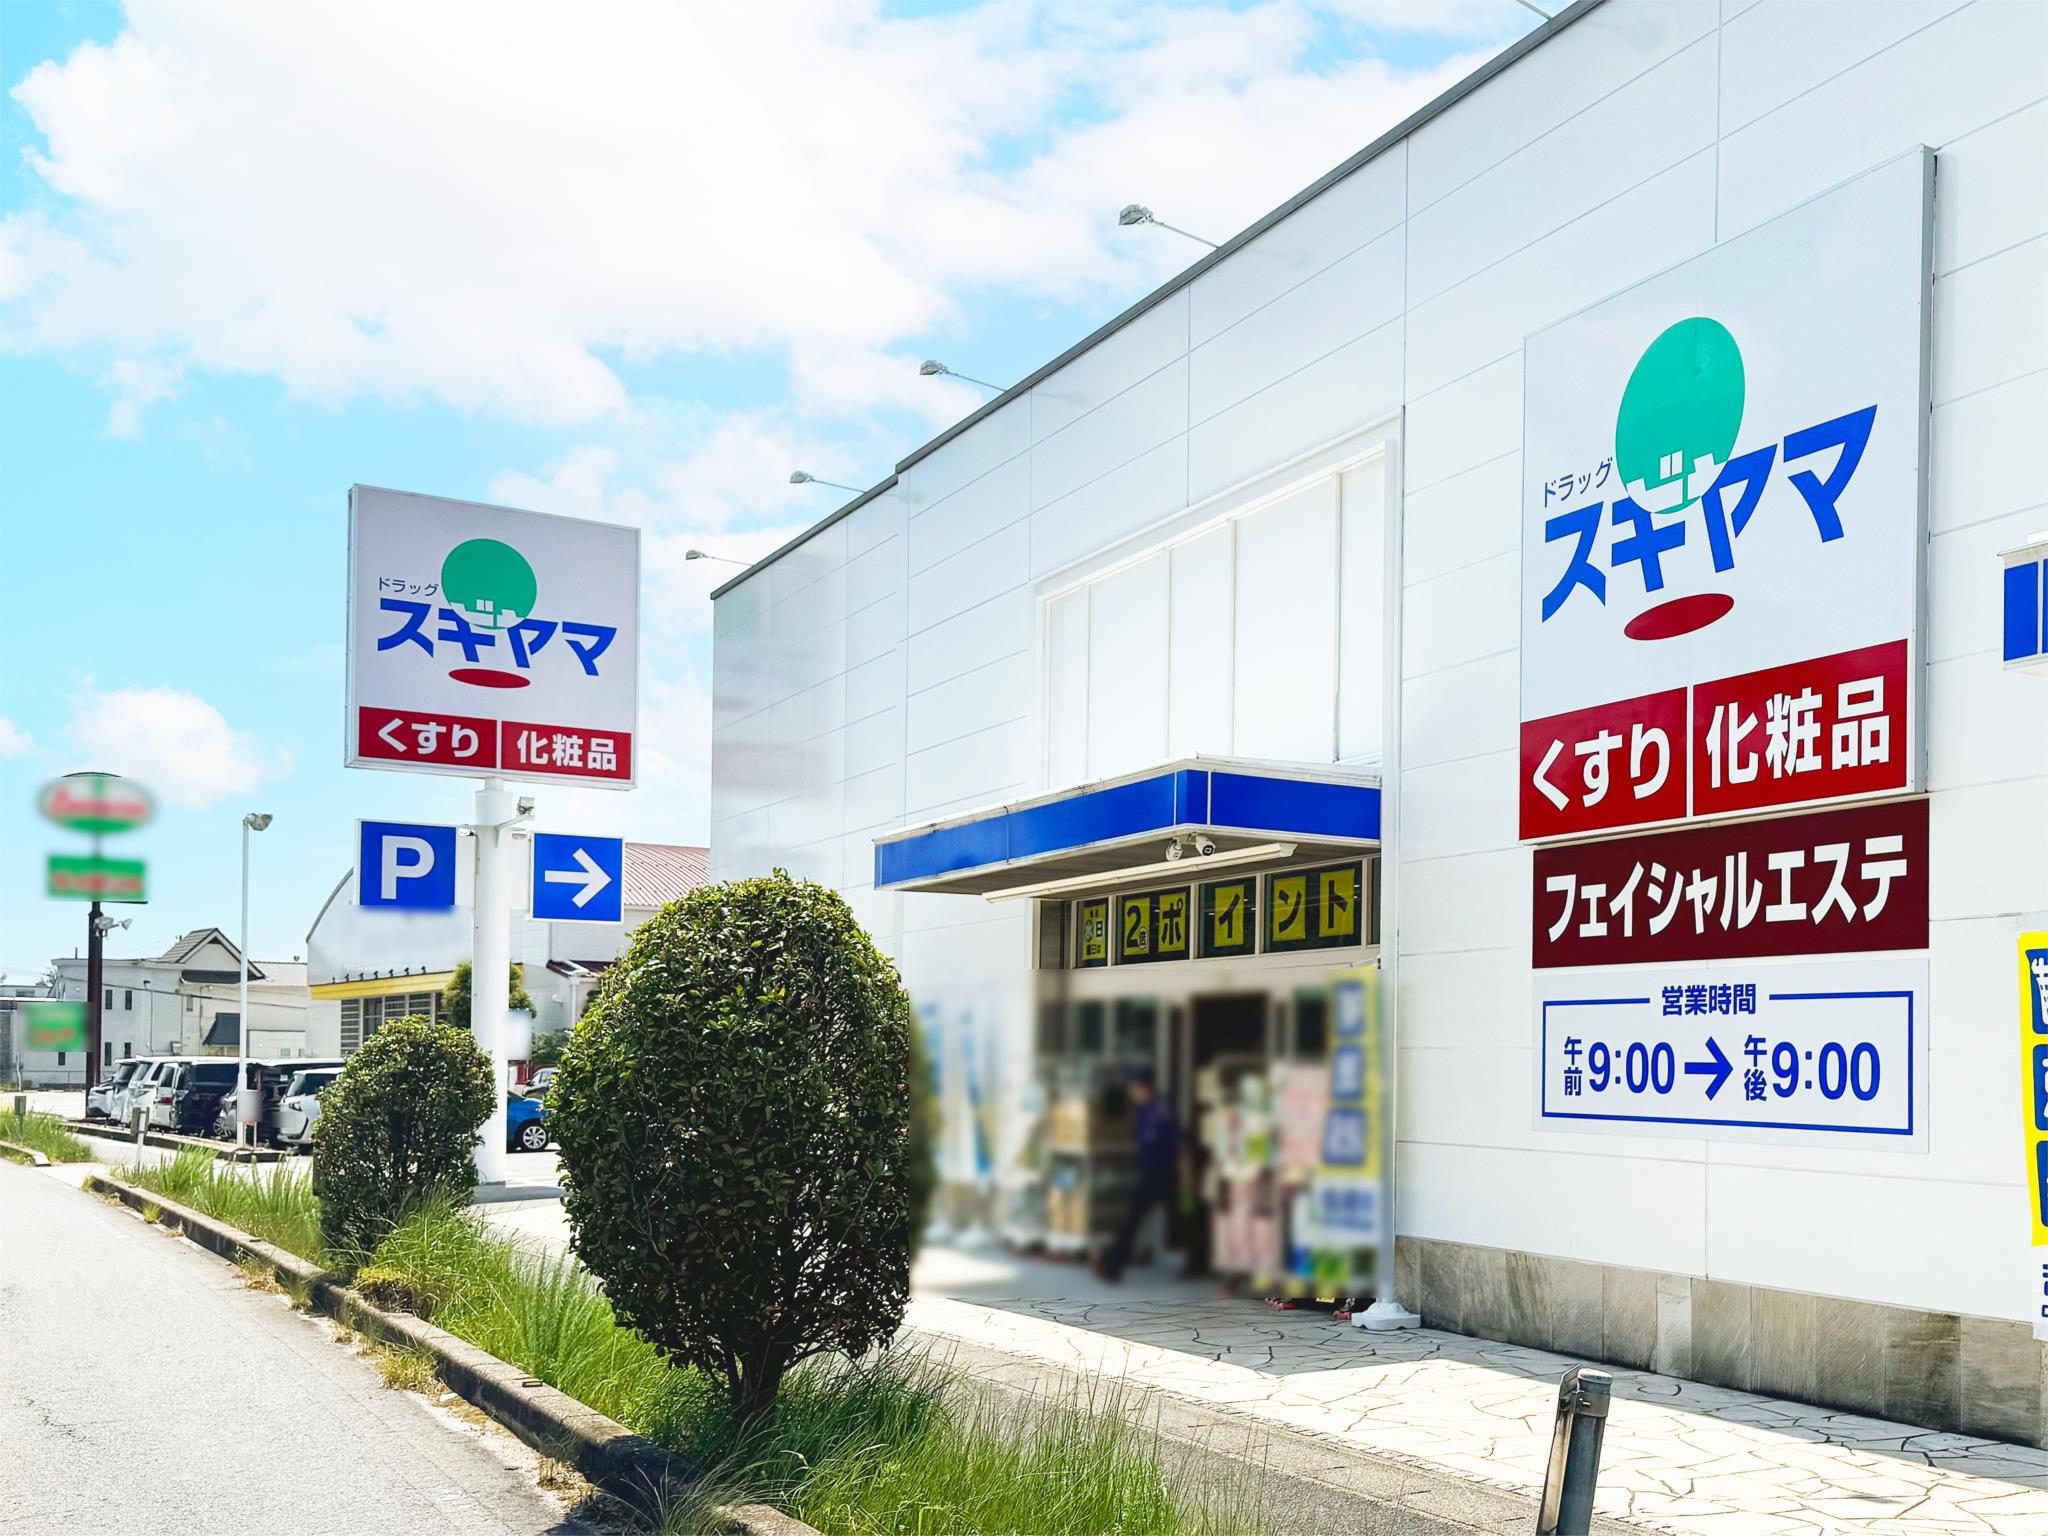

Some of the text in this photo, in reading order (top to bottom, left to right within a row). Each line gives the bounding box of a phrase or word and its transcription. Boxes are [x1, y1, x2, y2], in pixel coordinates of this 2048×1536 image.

[1543, 456, 1613, 508] ドラッグ
[379, 576, 439, 597] ドラッグ
[378, 717, 480, 758] くすり
[516, 730, 618, 772] 化粧品
[1705, 675, 1891, 789] 化粧品
[1532, 723, 1671, 812] くすり
[380, 834, 436, 901] P
[1545, 834, 1908, 943] フェイシャルエステ
[1661, 983, 1757, 1016] 営業時間
[1563, 1034, 1881, 1102] 午前 9:00 午後 9:00
